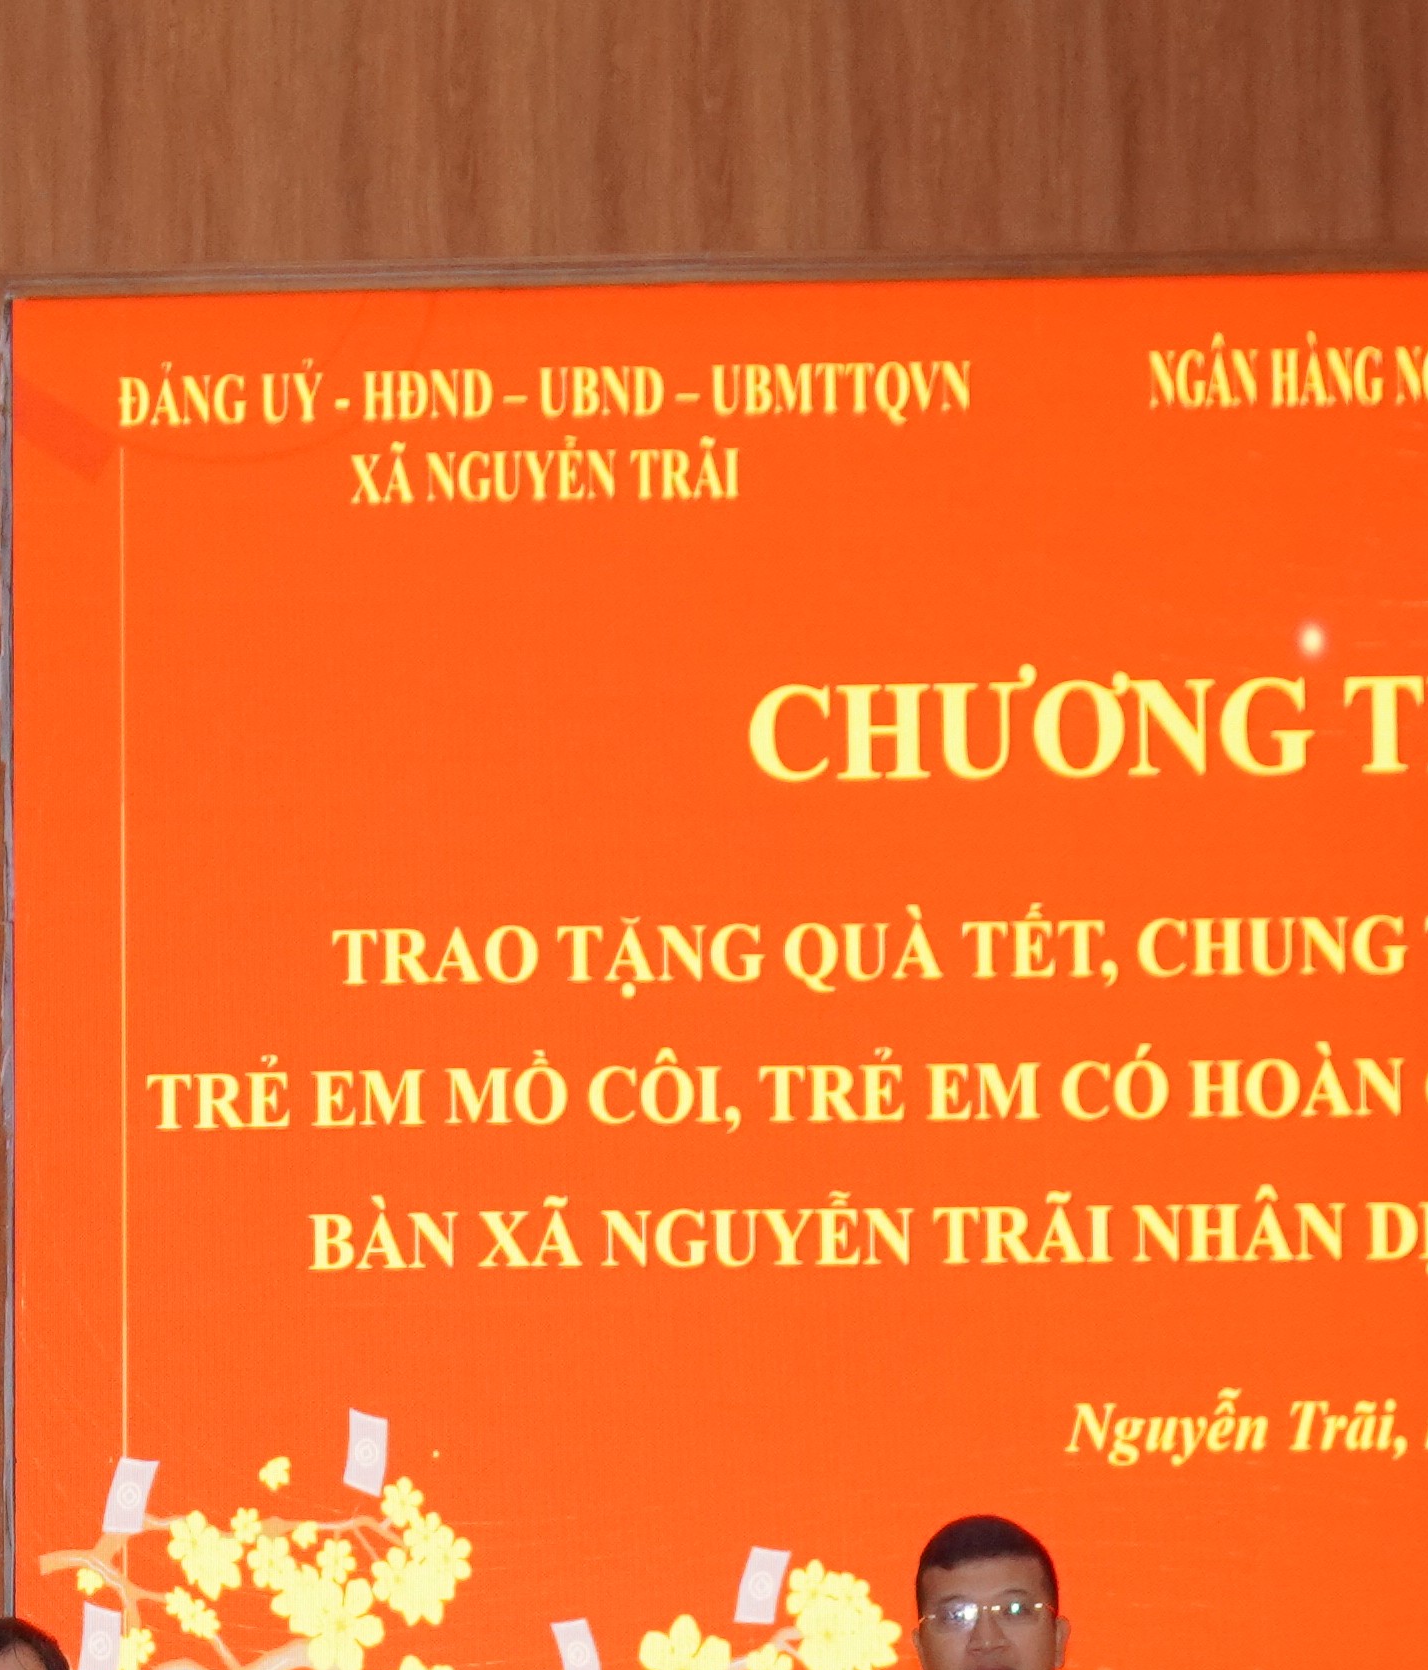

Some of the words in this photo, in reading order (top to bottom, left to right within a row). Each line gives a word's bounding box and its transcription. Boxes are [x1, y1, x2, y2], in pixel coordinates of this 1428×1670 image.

[117, 361, 247, 428] ĐẢNG
[363, 368, 494, 423] HĐND
[539, 365, 665, 419] UBND
[711, 360, 971, 426] UBMTTQVN
[1148, 331, 1258, 409] NGÂN
[350, 440, 415, 506] XÃ
[629, 435, 739, 501] TRÃI
[747, 663, 1316, 783] CHƯƠNG
[331, 924, 540, 987] TRAO
[556, 916, 766, 998] TẶNG
[782, 903, 944, 994] QUÀ
[961, 901, 1119, 987] TẾT,
[1136, 914, 1408, 979] CHUNG
[145, 1053, 291, 1132] TRẺ
[310, 1068, 426, 1129] EM
[444, 1048, 569, 1126] MỒ
[586, 1046, 742, 1134] CÔI,
[757, 1046, 905, 1124] TRẺ
[925, 1061, 1041, 1122] EM
[1059, 1042, 1170, 1122] CÓ
[1188, 1040, 1405, 1120] HOÀN
[308, 1194, 459, 1272] BÀN
[477, 1194, 584, 1269] XÃ
[600, 1189, 915, 1269] NGUYỄN
[931, 1189, 1114, 1266] TRÃI
[1131, 1183, 1347, 1263] NHÂN
[1063, 1388, 1269, 1468] Nguyễn
[1287, 1397, 1409, 1460] Trãi,
